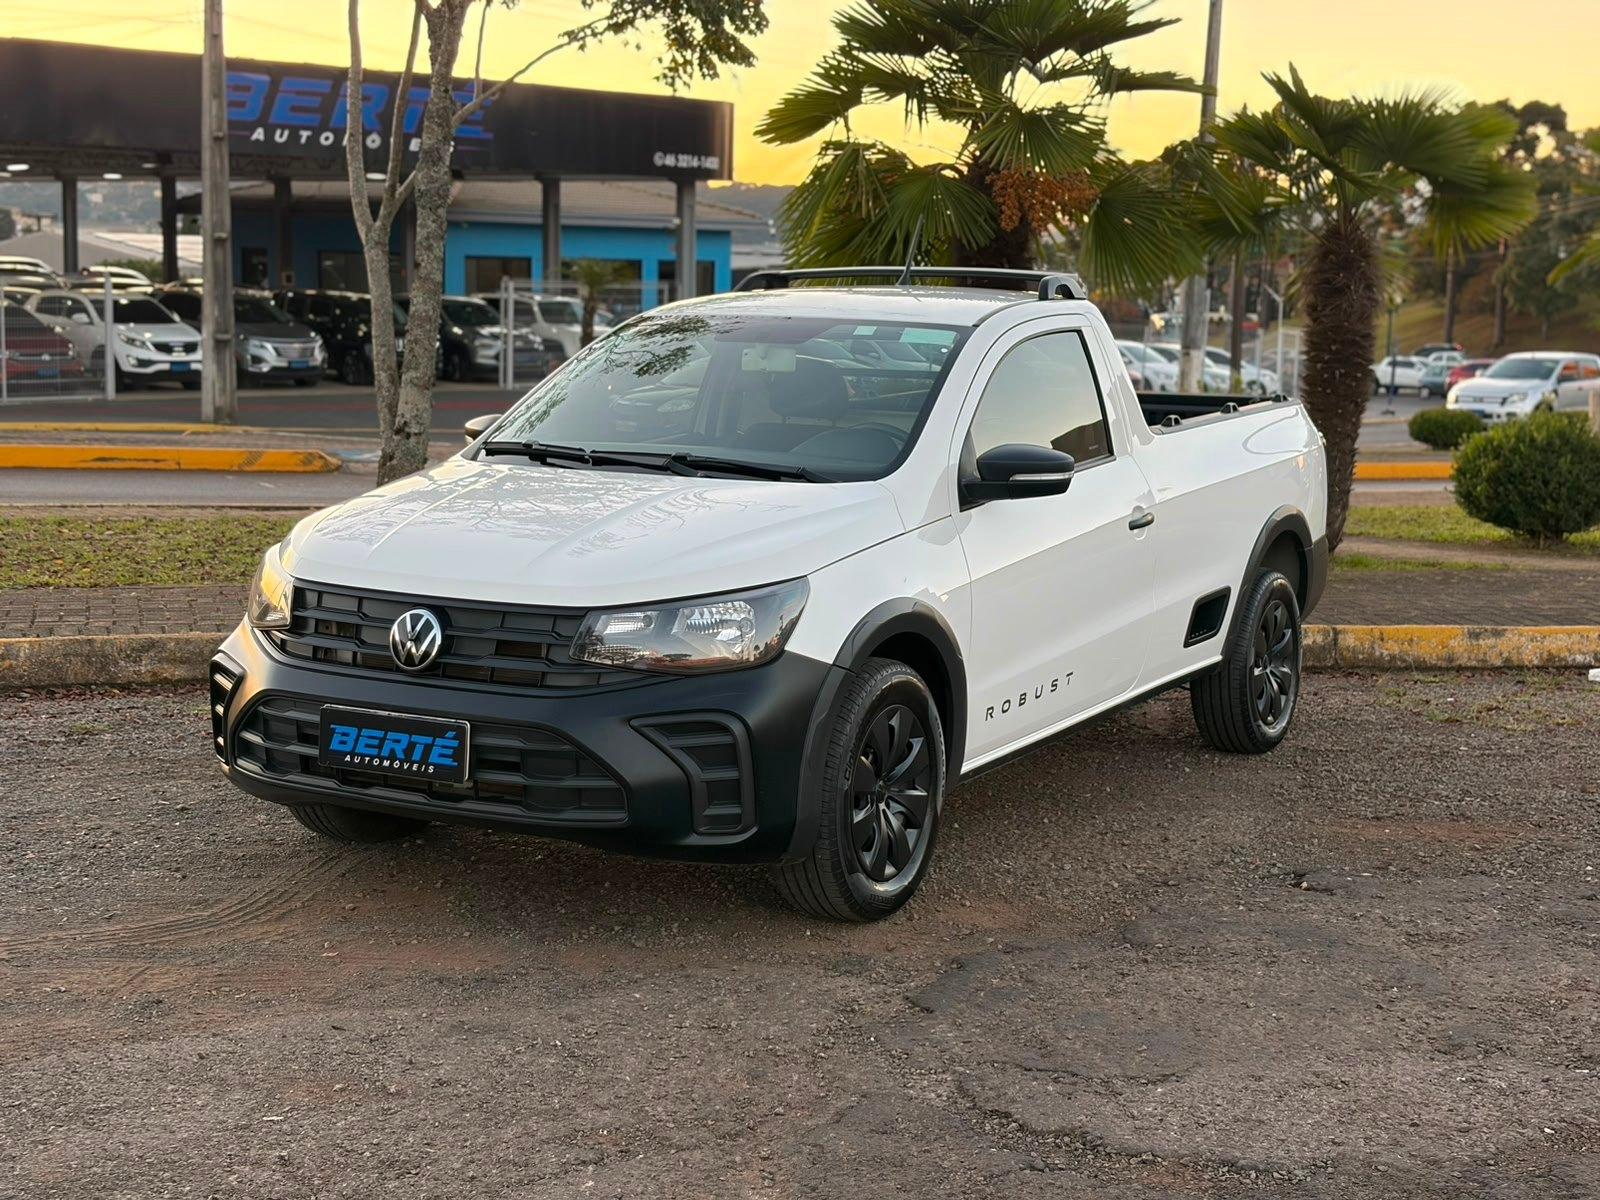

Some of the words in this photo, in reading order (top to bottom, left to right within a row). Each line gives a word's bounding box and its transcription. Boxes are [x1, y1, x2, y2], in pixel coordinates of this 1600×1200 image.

[984, 671, 1074, 721] ROBUST
[329, 724, 460, 767] BERTÉ
[344, 754, 436, 774] AUTOMÓVEIS
